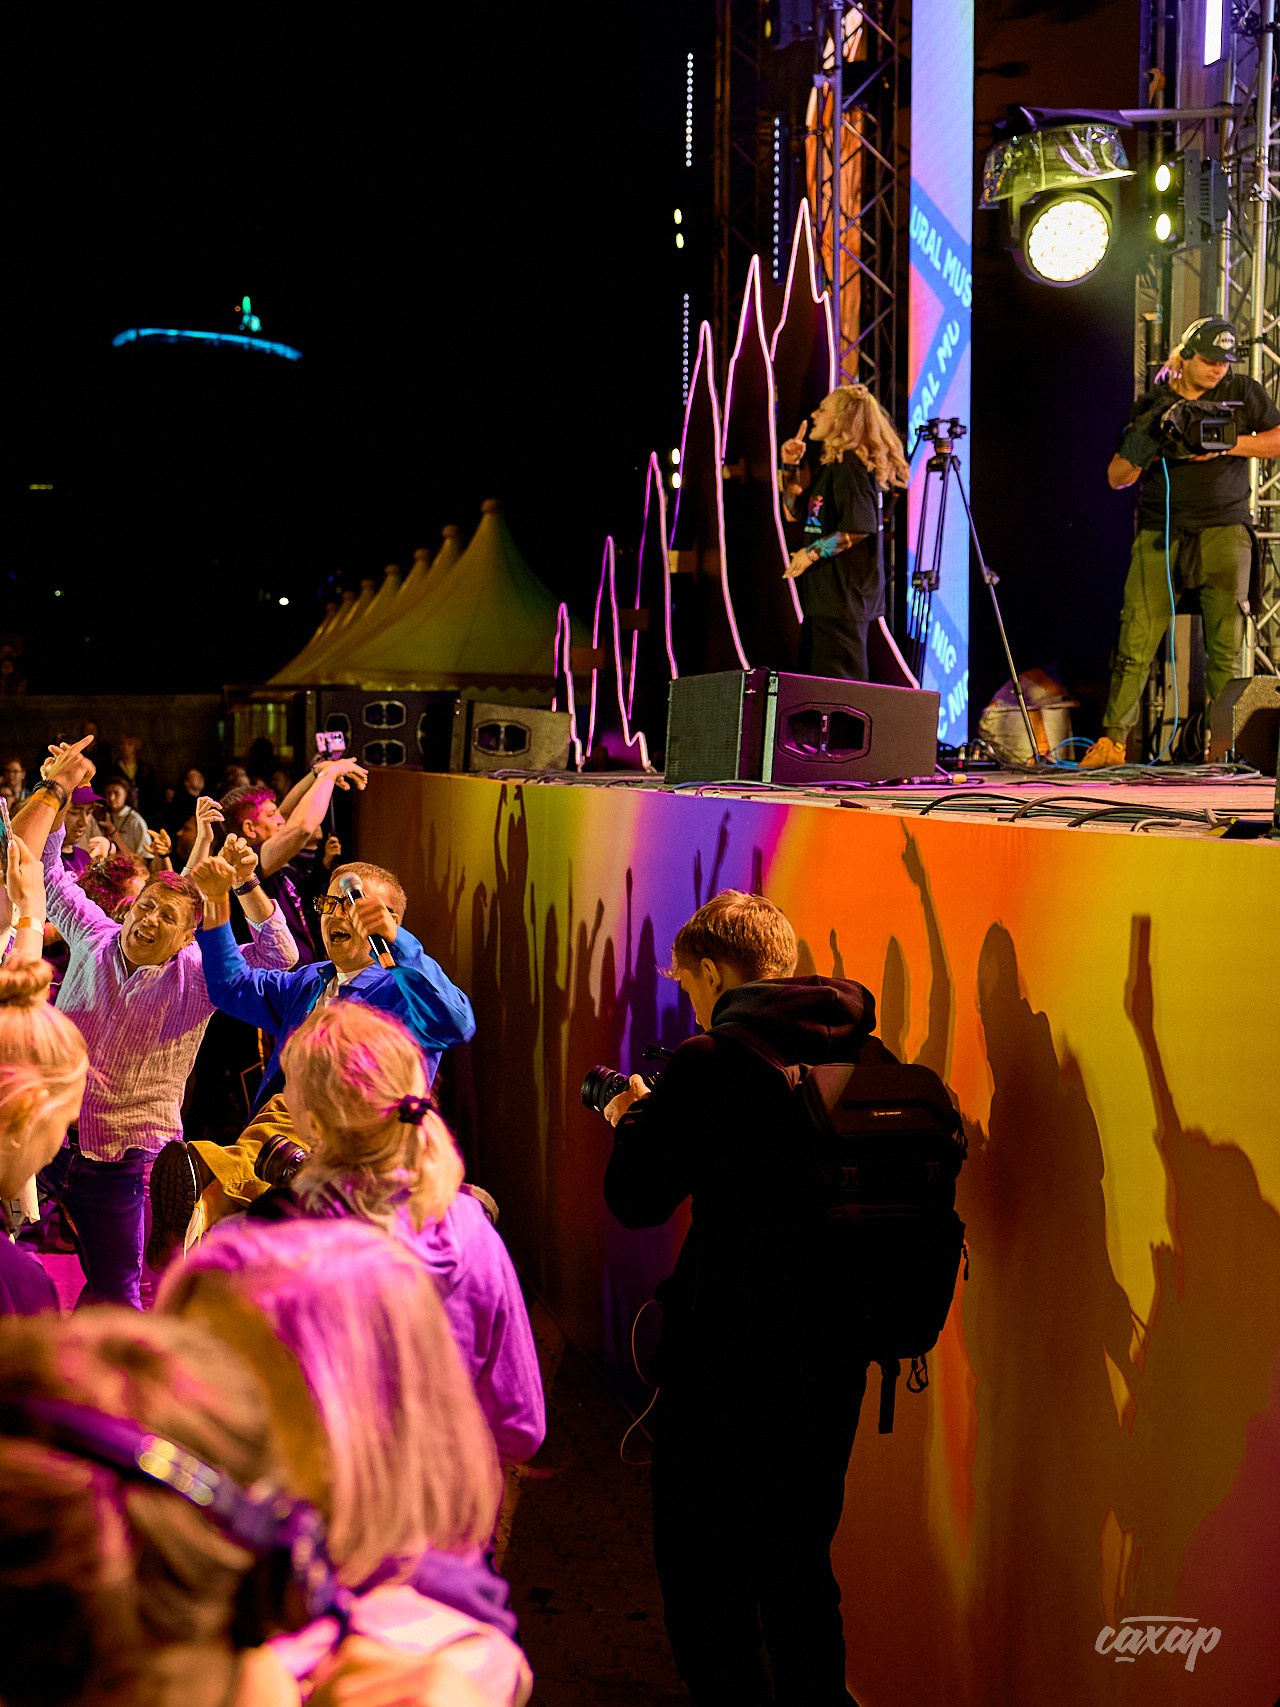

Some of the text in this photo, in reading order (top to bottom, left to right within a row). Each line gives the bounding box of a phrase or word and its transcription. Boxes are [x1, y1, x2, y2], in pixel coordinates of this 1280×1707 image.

[909, 205, 972, 308] URAL MUS
[937, 319, 960, 374] MU
